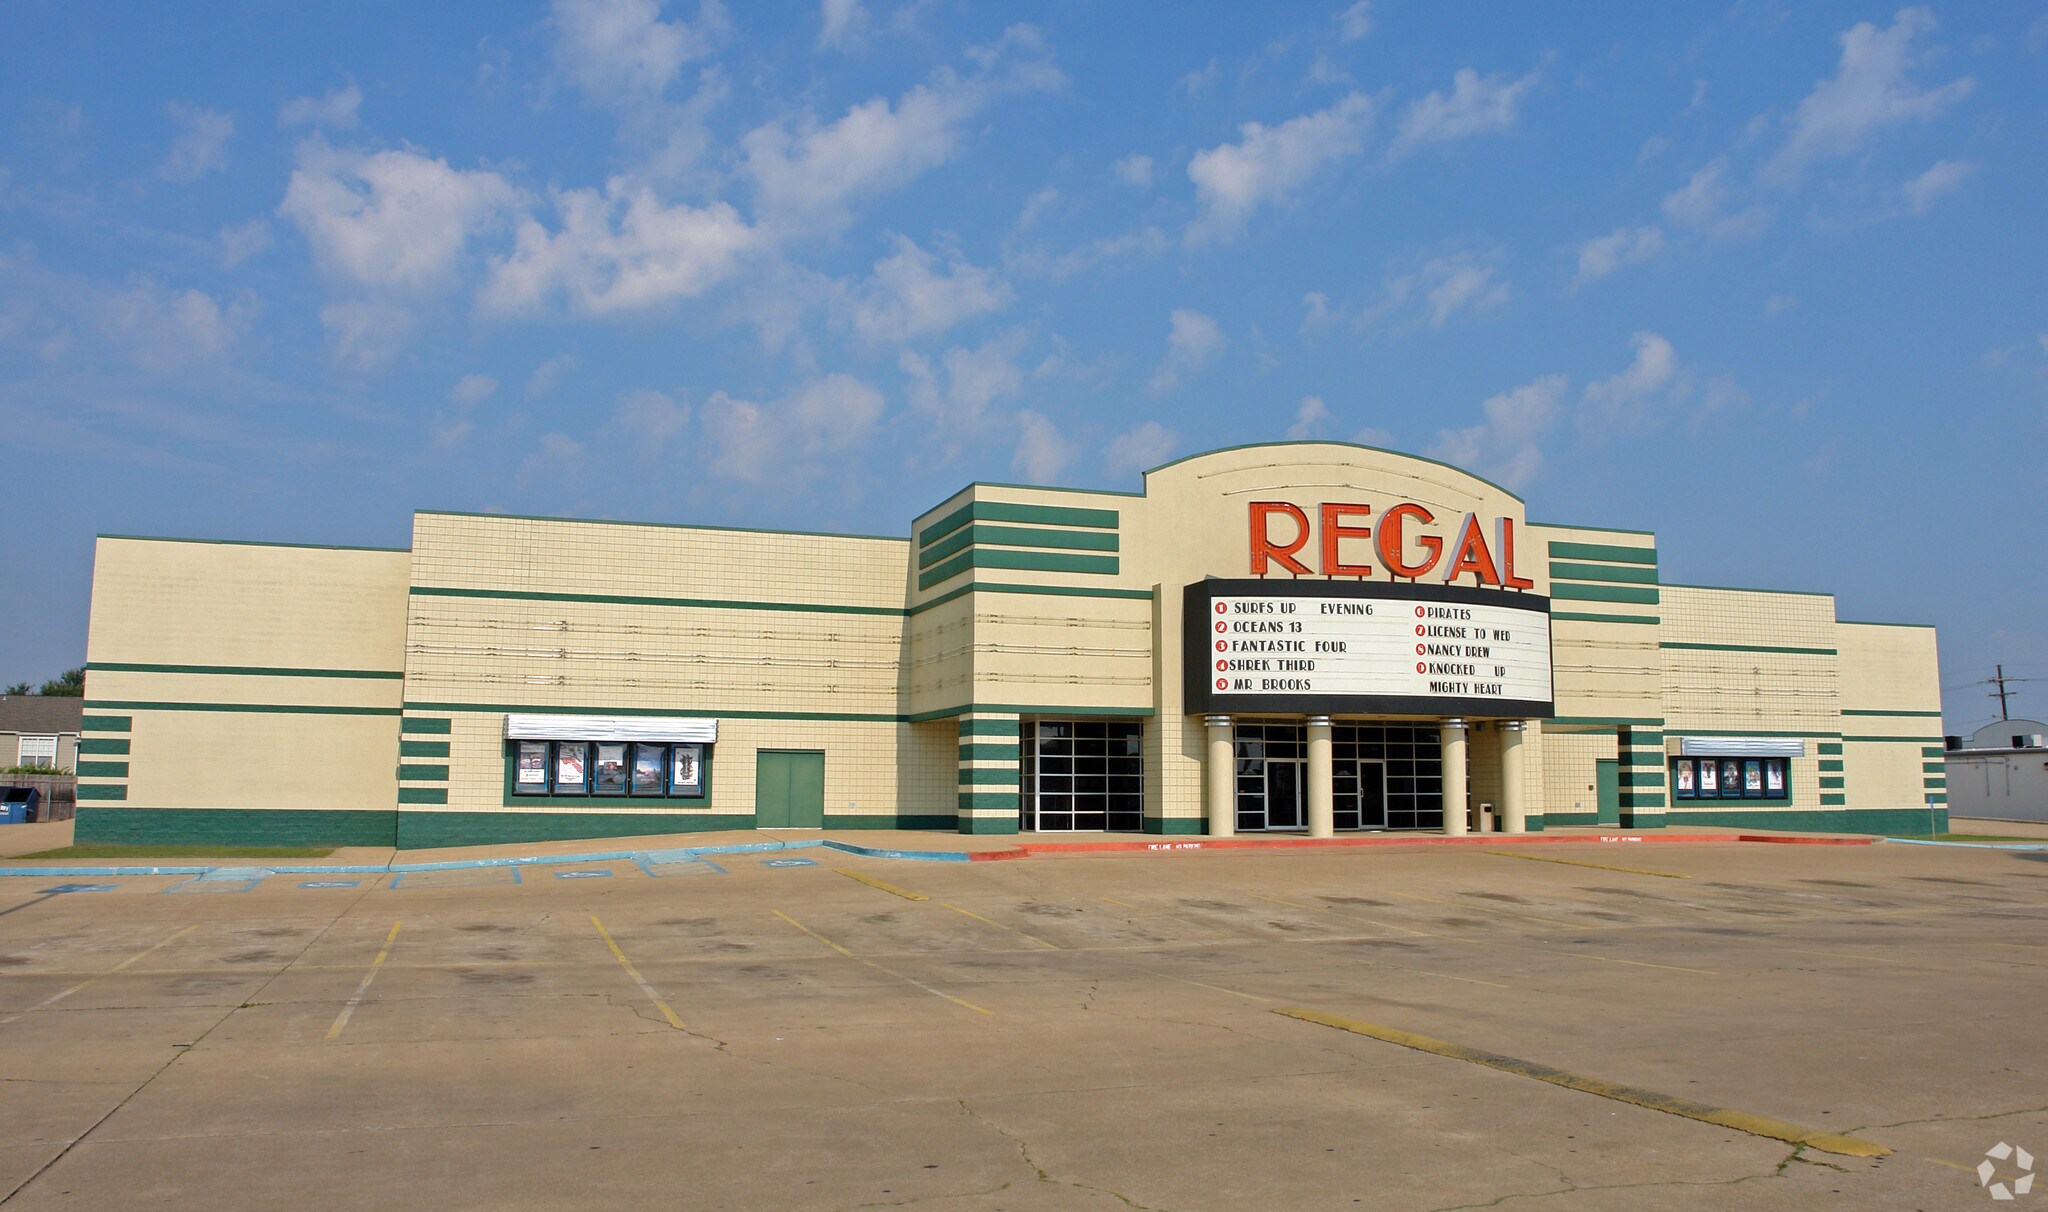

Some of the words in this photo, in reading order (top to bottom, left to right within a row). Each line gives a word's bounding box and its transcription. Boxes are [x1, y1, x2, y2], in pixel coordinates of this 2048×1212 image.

[1248, 501, 1534, 589] REGAL
[1234, 602, 1274, 614] SURFS
[1280, 602, 1296, 614] UP
[1320, 603, 1373, 615] EVENING
[1428, 607, 1471, 620] PIRATES
[1233, 621, 1284, 633] OCEANS
[1288, 622, 1302, 632] 13
[1428, 625, 1466, 638] LICENSE
[1474, 628, 1486, 639] TO
[1493, 630, 1510, 641] WED
[1232, 640, 1306, 652] FANTASTIC
[1315, 640, 1346, 652] FOUR
[1428, 644, 1462, 656] NANCY
[1466, 646, 1490, 658] DREW
[1229, 660, 1270, 671] SHREK
[1278, 660, 1315, 671] THIRD
[1429, 662, 1476, 676] KNOCKED
[1494, 666, 1506, 677] UP
[1234, 679, 1252, 690] MR
[1262, 678, 1311, 690] BROOKS
[1430, 682, 1468, 693] MIGHTY
[1474, 684, 1502, 694] HEART
